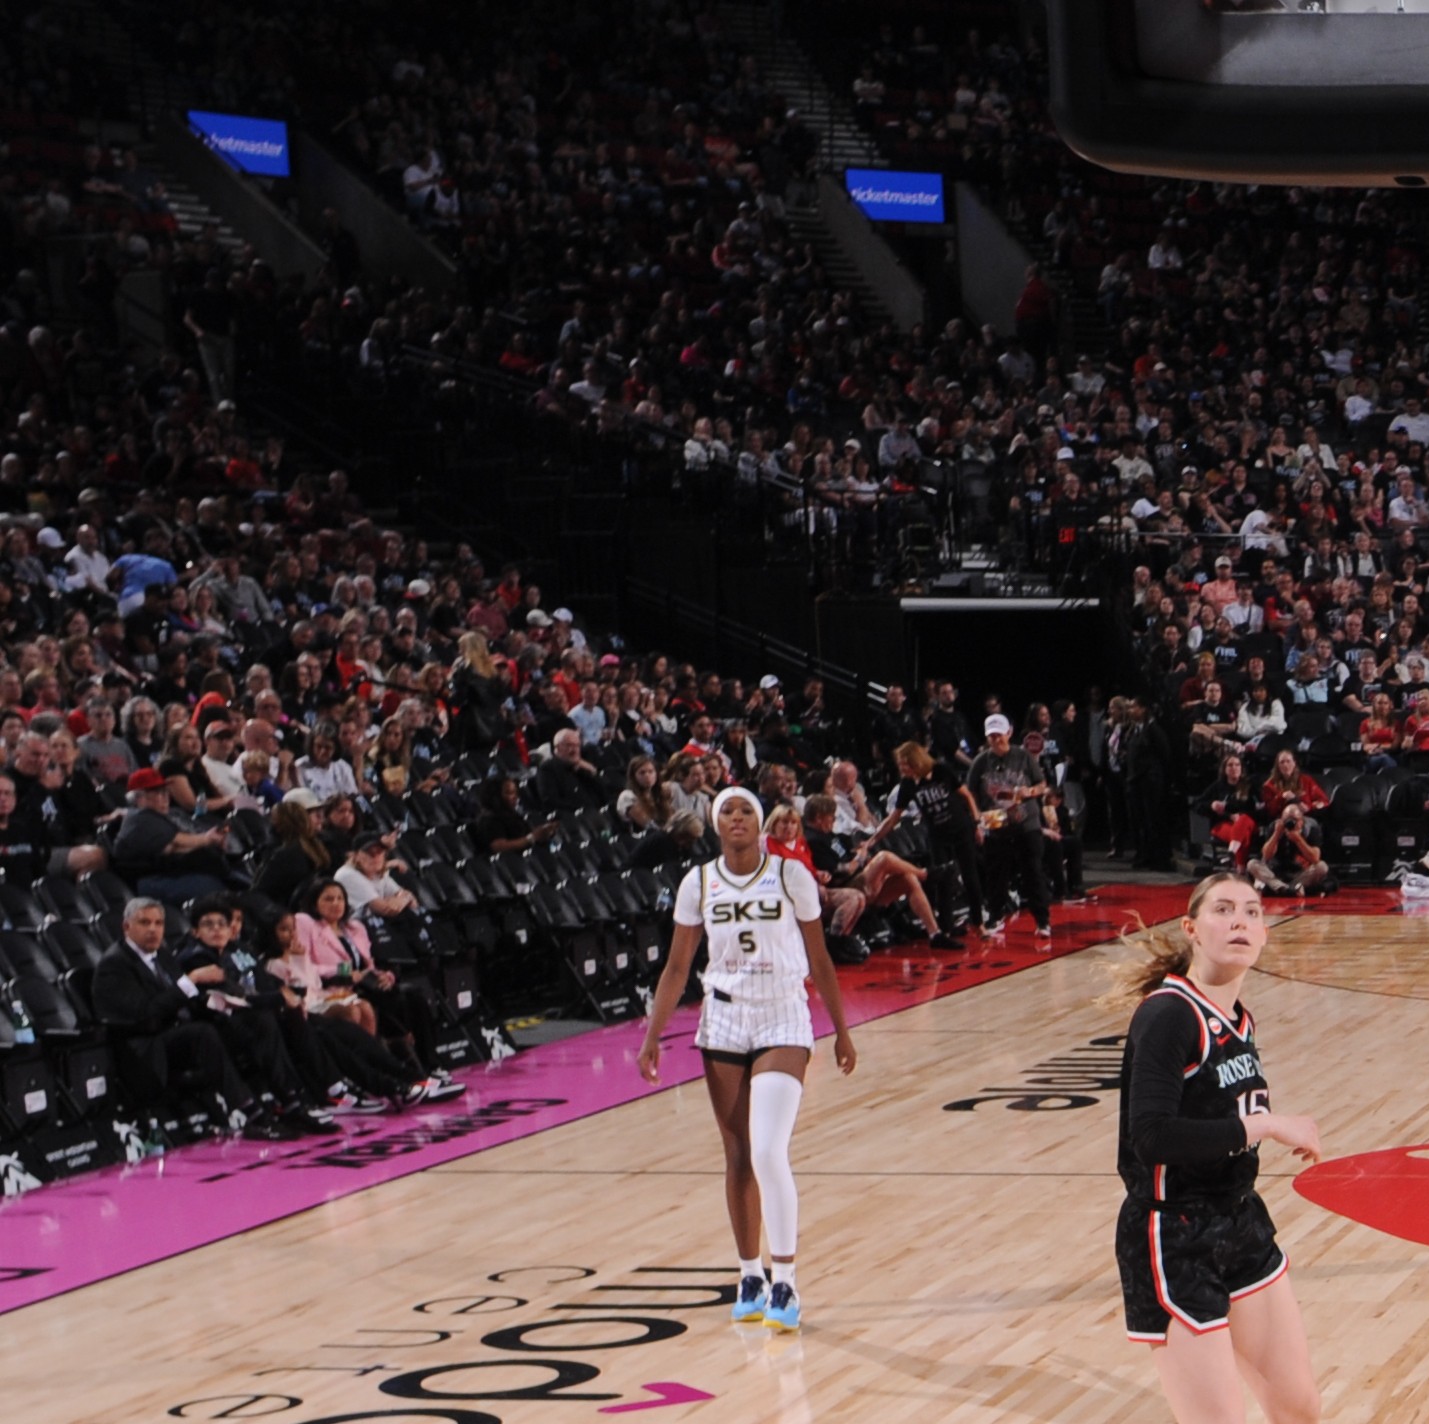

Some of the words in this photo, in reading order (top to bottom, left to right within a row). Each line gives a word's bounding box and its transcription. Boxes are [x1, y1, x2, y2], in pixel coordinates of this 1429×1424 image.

[711, 900, 784, 925] SKY
[738, 930, 756, 955] 5
[1216, 1053, 1256, 1089] ROSE
